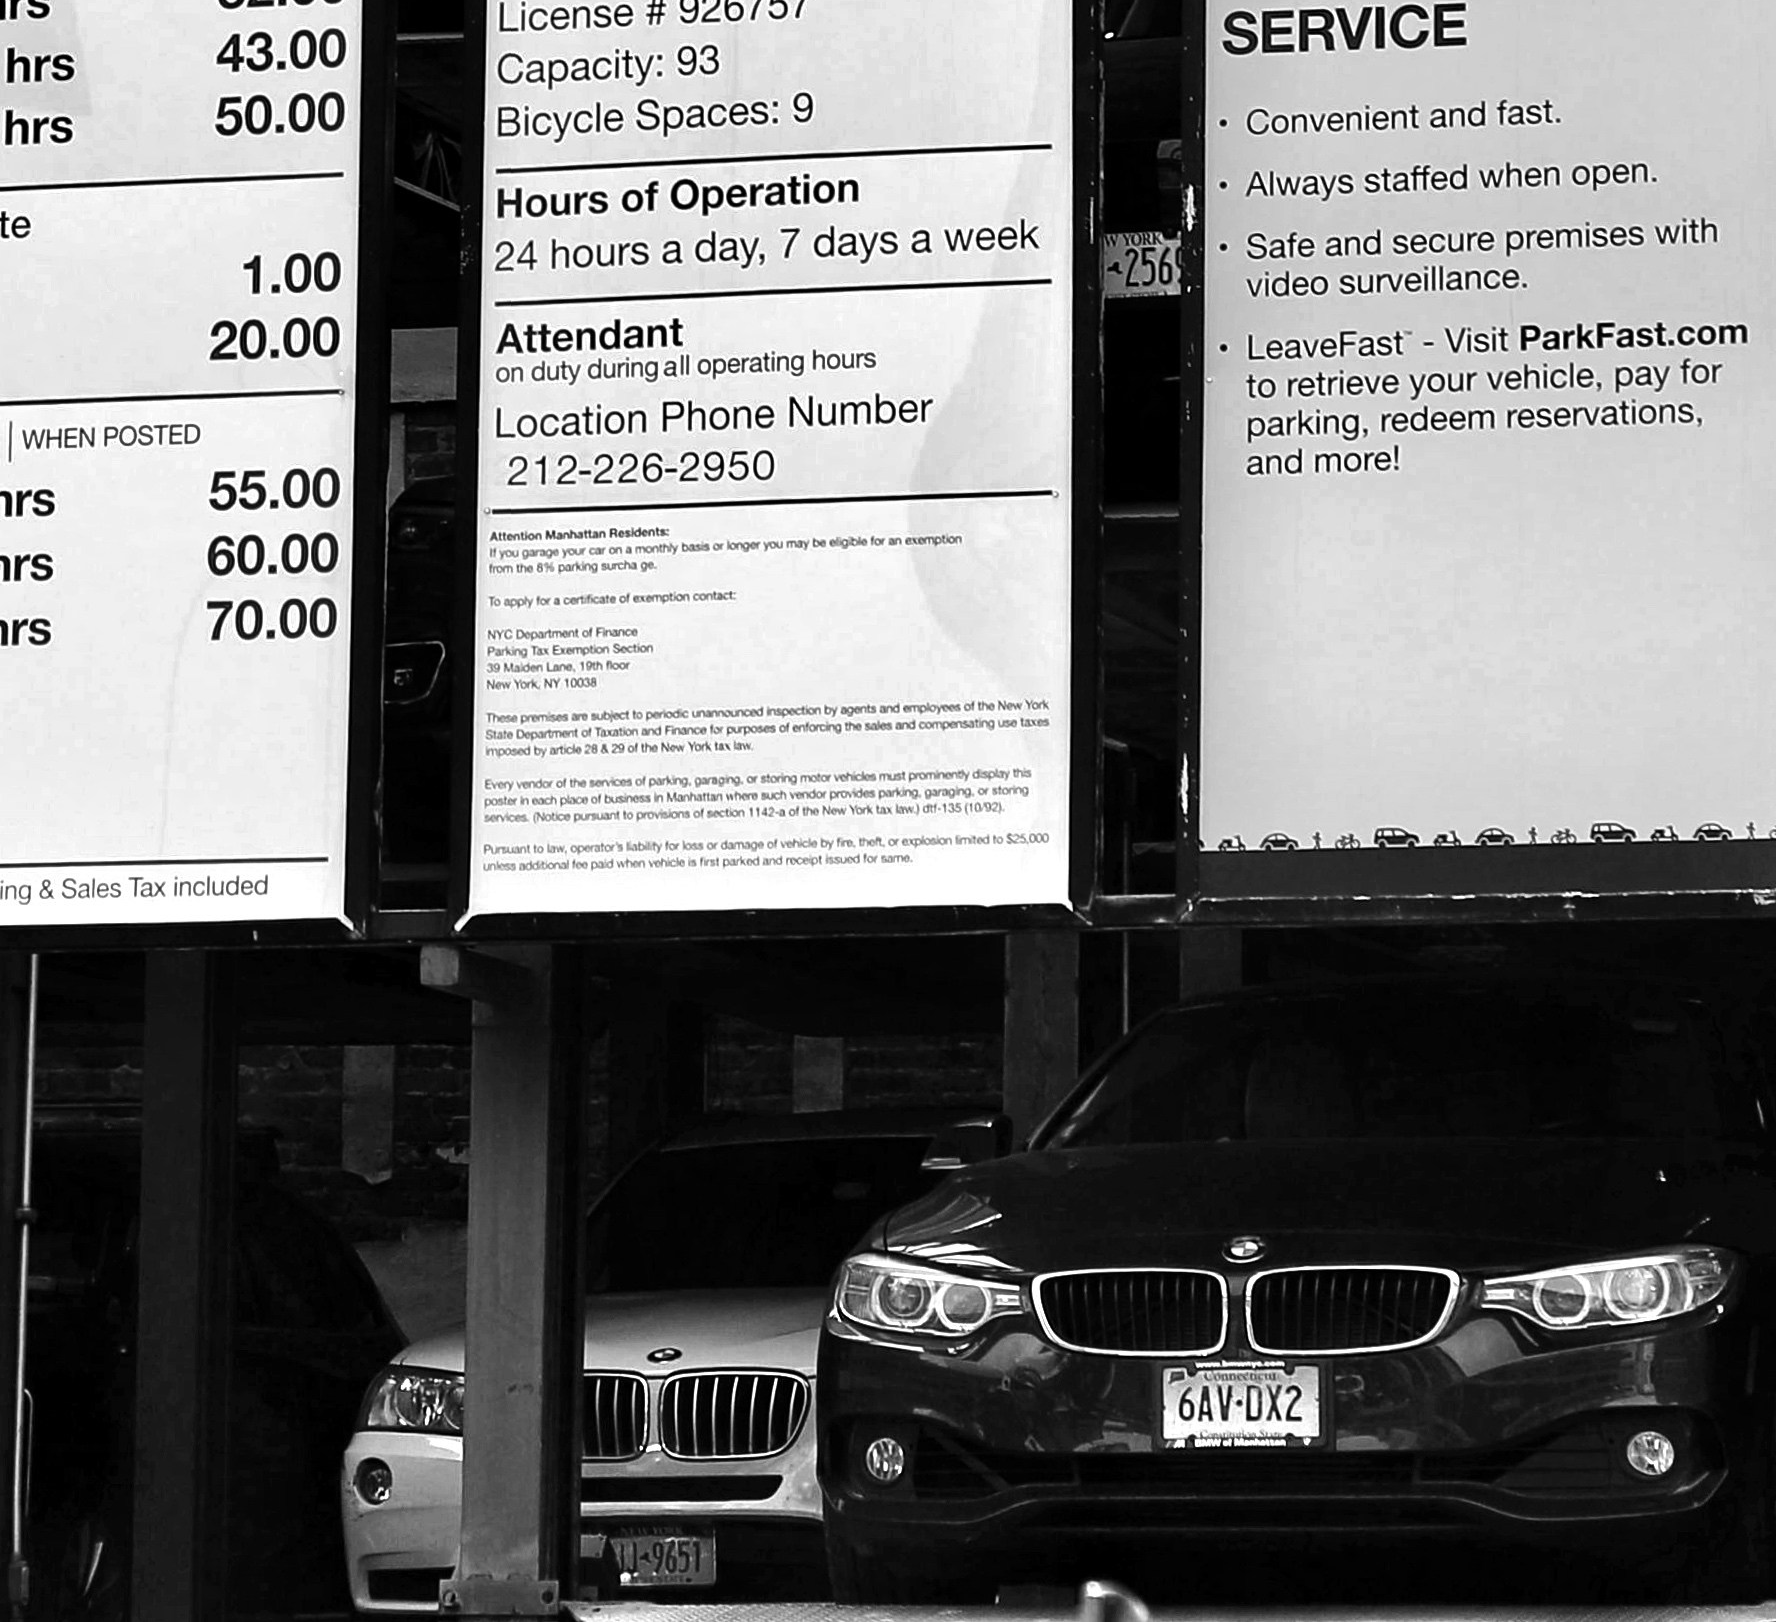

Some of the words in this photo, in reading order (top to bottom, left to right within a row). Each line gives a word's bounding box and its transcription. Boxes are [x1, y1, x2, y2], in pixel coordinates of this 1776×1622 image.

[499, 1, 634, 32] License
[1222, 2, 1467, 55] SERVICE
[497, 49, 663, 90] Capacity:
[677, 45, 719, 76] 93
[497, 102, 624, 143] Bicycle
[636, 99, 778, 137] Spaces:
[793, 92, 813, 123] 9
[1247, 104, 1420, 135] Convenient
[1430, 101, 1486, 128] and
[1496, 99, 1561, 126] fast.
[497, 187, 608, 219] Hours
[622, 181, 659, 212] of
[670, 173, 859, 216] Operation
[1245, 170, 1354, 202] Always
[1363, 163, 1468, 193] staffed
[1478, 161, 1560, 188] when
[1571, 163, 1657, 192] open.
[243, 251, 341, 294] 1.00
[209, 316, 340, 361] 20.00
[496, 318, 683, 354] Attendant
[1444, 327, 1509, 353] Visit
[1520, 322, 1748, 352] ParkFast.com
[496, 367, 523, 383] on
[531, 361, 581, 385] duty
[588, 357, 658, 383] during
[663, 354, 689, 377] all
[697, 351, 804, 380] operating
[813, 349, 876, 370] hours
[496, 404, 647, 438] Location
[662, 400, 775, 432] Phone
[789, 393, 933, 427] Number
[22, 427, 95, 450] WHEN
[104, 424, 200, 447] POSTED
[507, 450, 774, 486] 212-226-2950
[490, 531, 542, 541] Attention
[545, 530, 606, 540] Manhattan
[609, 528, 669, 538] Residents:
[487, 630, 513, 640] NYC
[516, 629, 579, 641] Department
[582, 628, 593, 638] of
[596, 627, 638, 637] Finance
